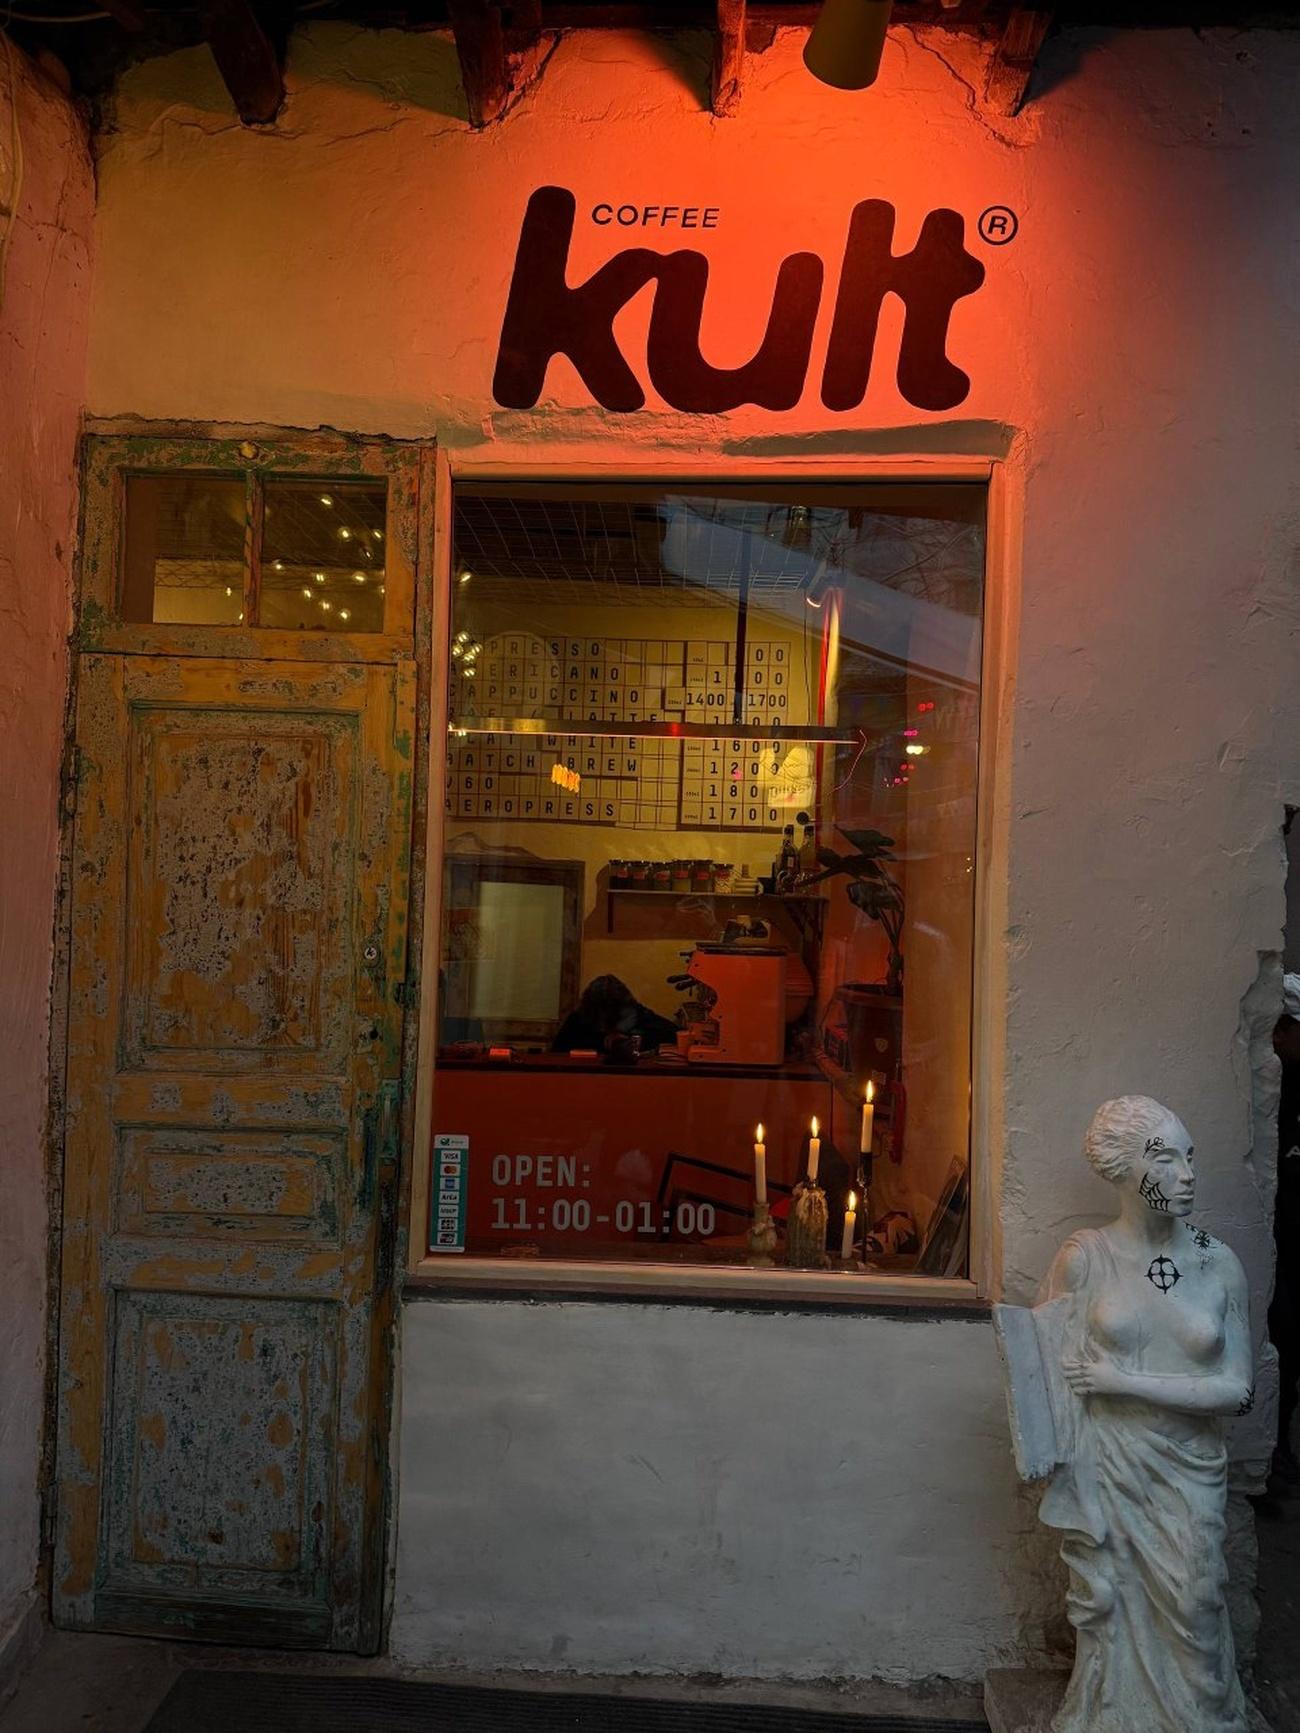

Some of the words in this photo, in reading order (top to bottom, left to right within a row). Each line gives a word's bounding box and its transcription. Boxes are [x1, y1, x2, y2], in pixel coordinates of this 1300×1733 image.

[591, 203, 720, 229] COFFEE
[492, 185, 985, 414] kult
[450, 663, 619, 681] AERICANO
[712, 671, 784, 686] 100
[686, 693, 725, 707] 1400
[748, 693, 786, 708] 1700
[547, 735, 637, 750] WHITE
[711, 739, 780, 754] 1600
[567, 757, 637, 772] BREW
[710, 761, 779, 776] 1200
[708, 807, 777, 821] 1700
[491, 1154, 592, 1188] OPEN:
[490, 1197, 716, 1236] 11:00-01:00
